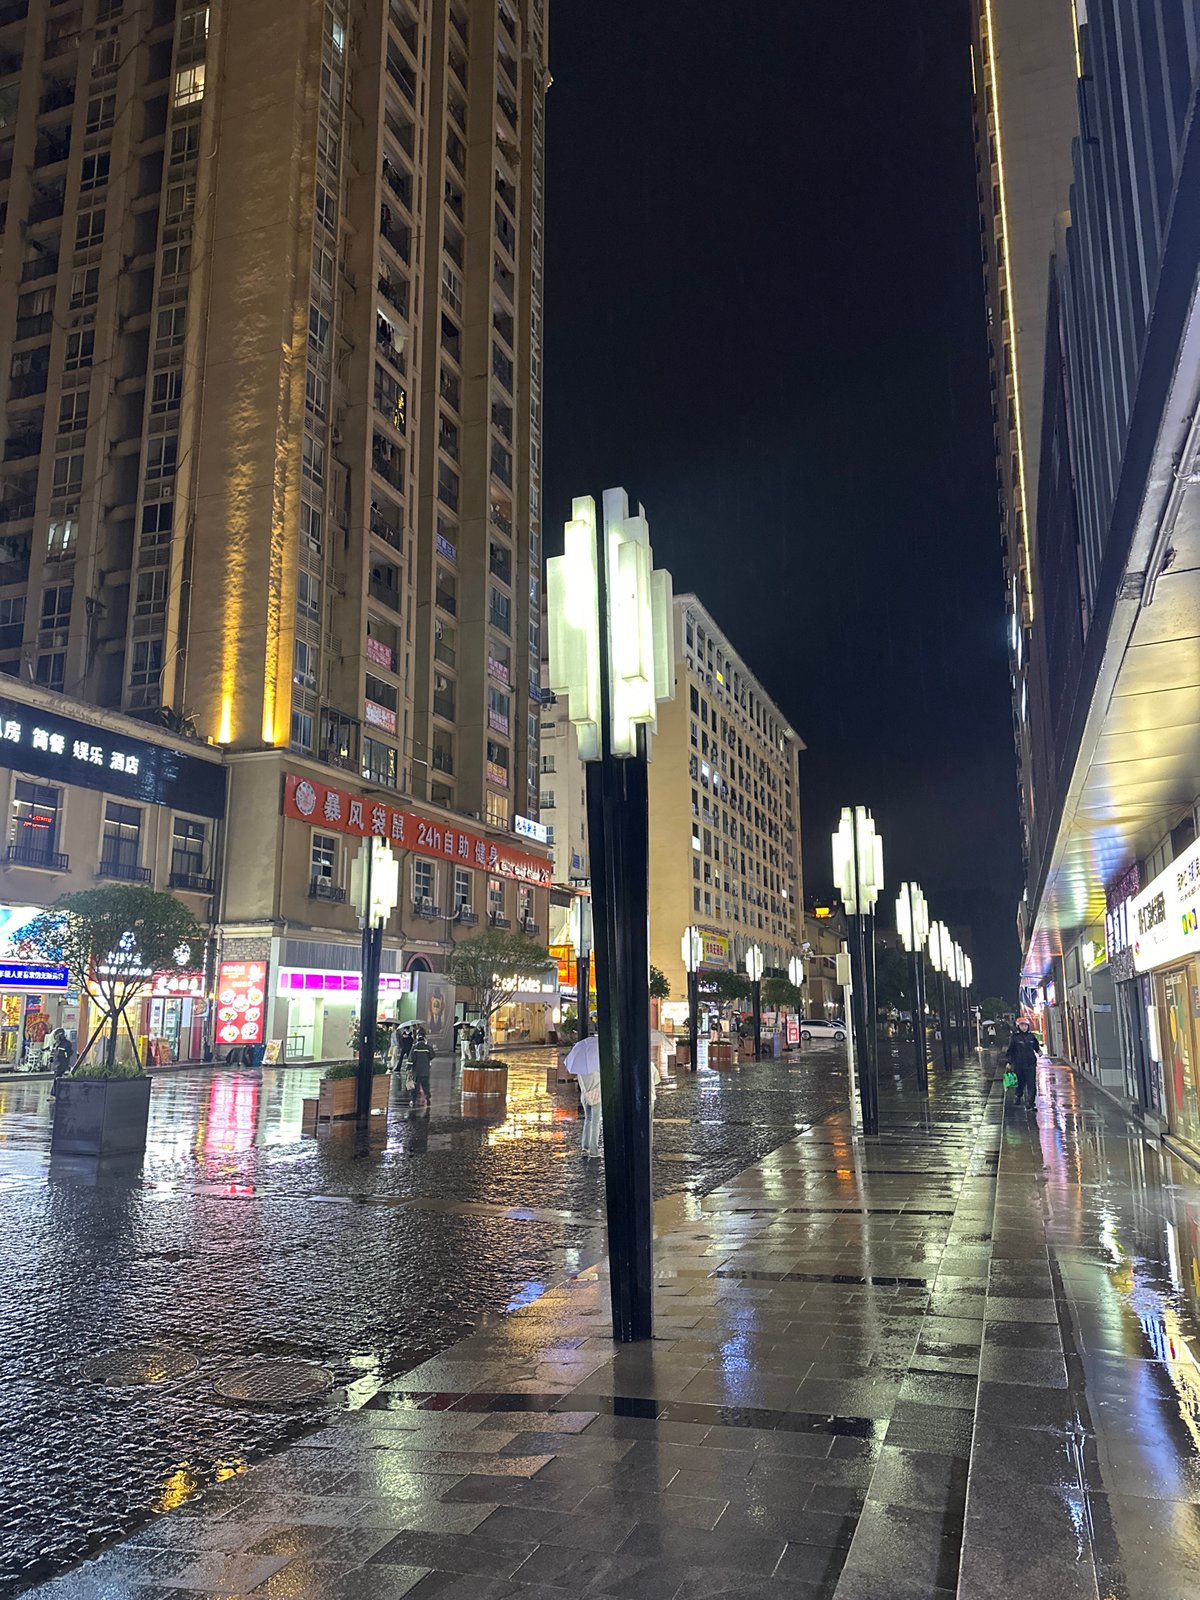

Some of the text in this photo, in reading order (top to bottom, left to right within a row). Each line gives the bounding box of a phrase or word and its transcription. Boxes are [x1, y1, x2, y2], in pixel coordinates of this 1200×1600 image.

[0, 717, 139, 775] 房 简餐 娱乐 酒店
[324, 791, 405, 842] 暴风袋鼠
